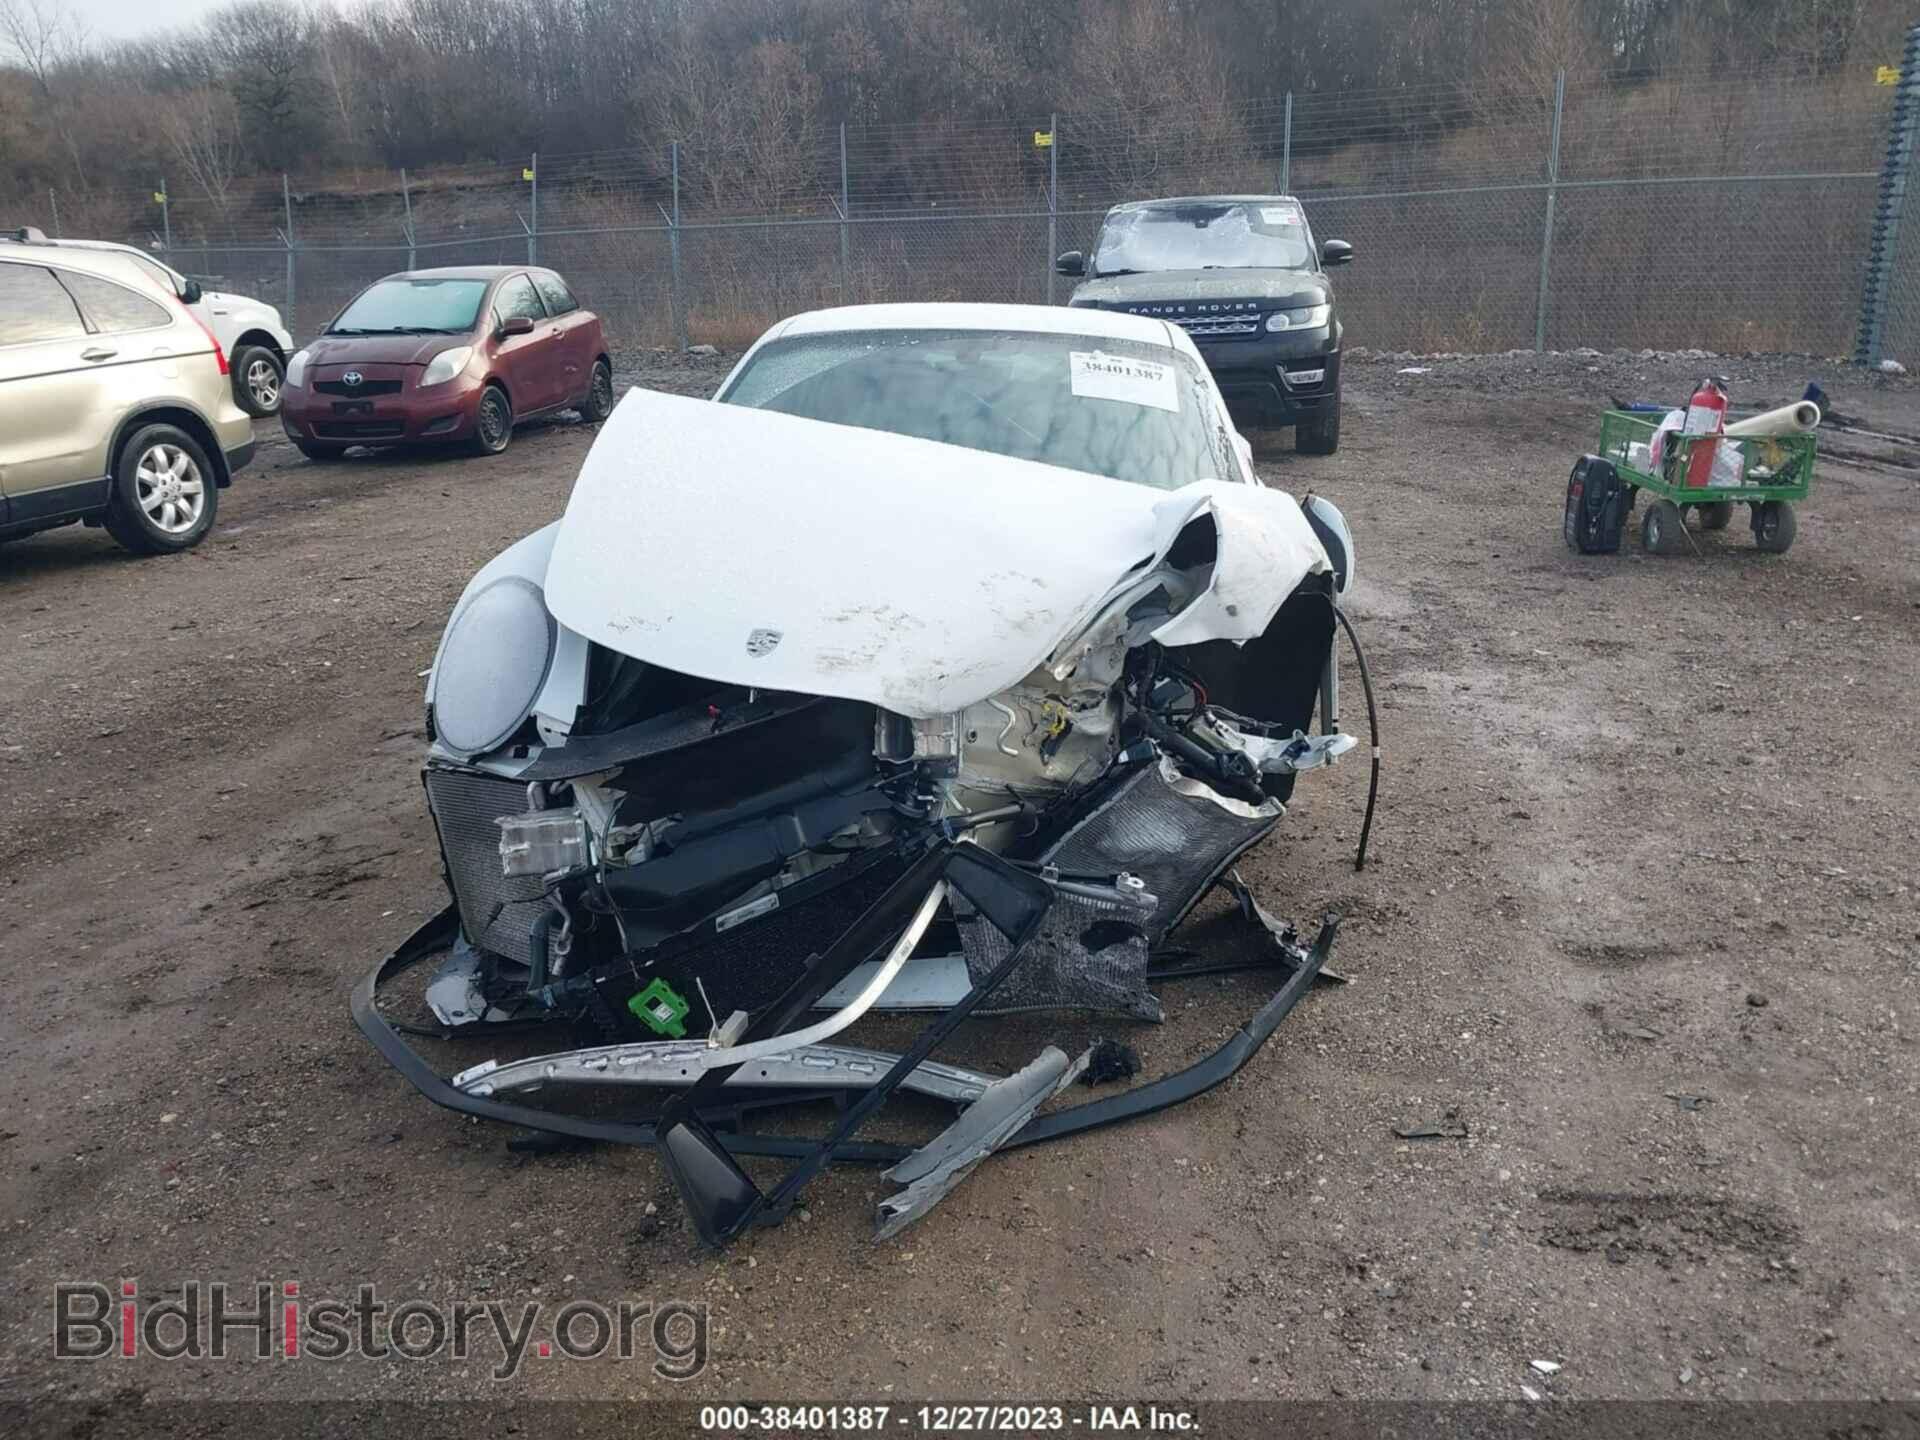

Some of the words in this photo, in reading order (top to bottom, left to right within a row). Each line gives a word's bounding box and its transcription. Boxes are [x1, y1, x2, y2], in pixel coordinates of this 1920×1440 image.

[1128, 306, 1186, 314] RANGE
[1198, 303, 1257, 312] ROVER
[1081, 361, 1164, 382] 38401387
